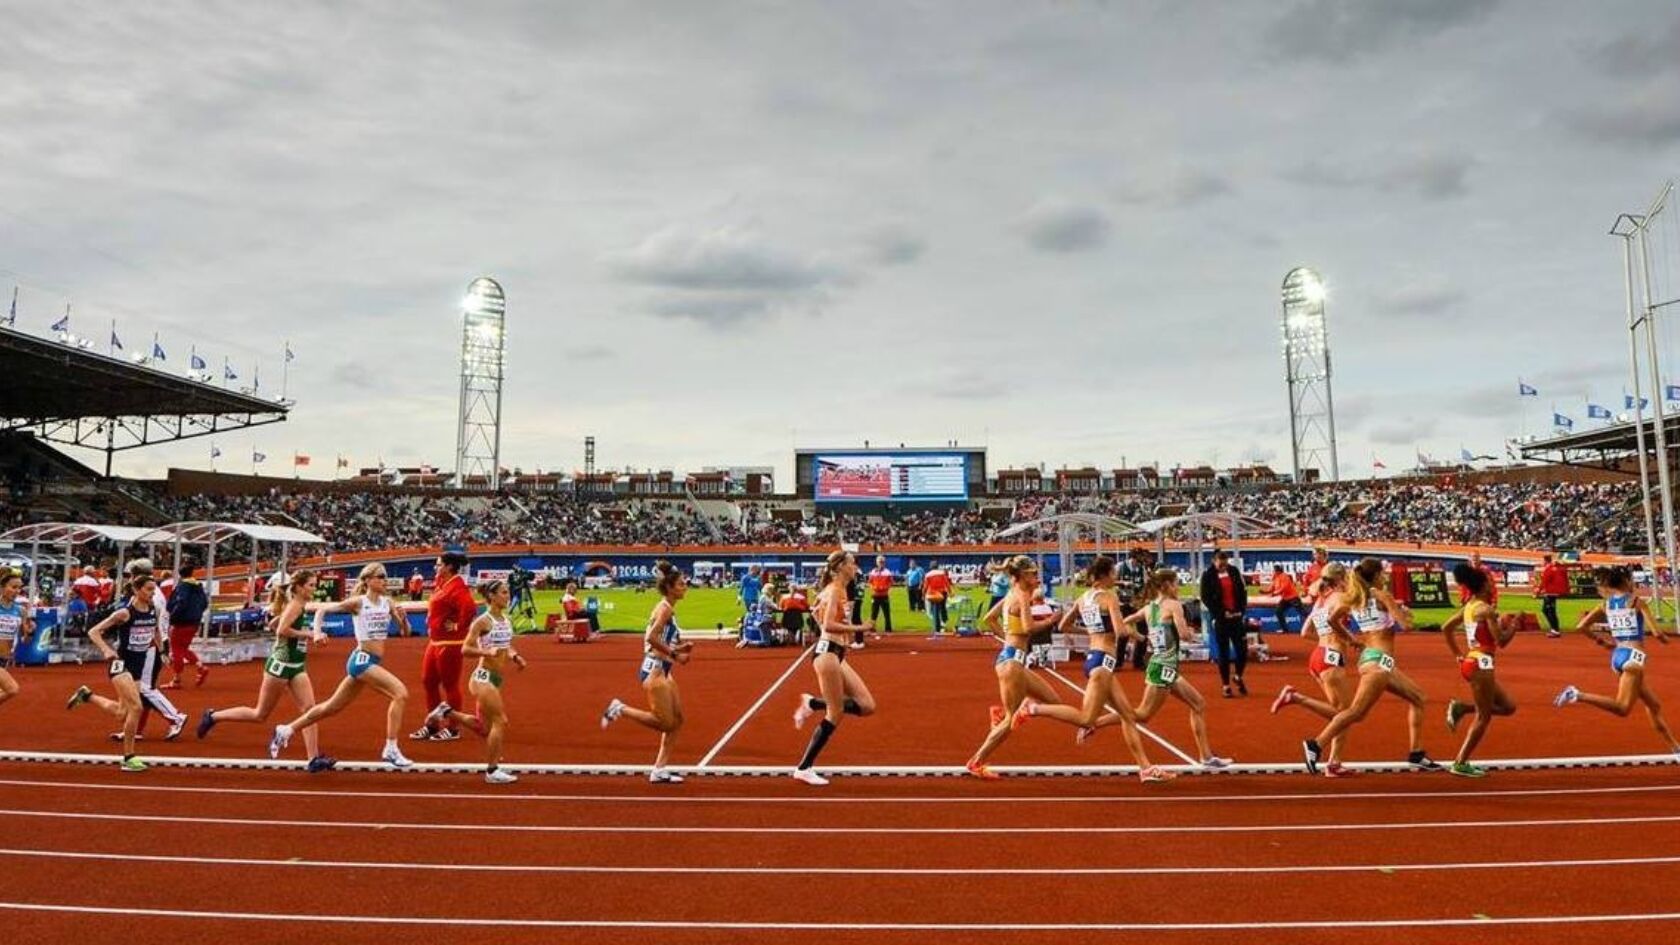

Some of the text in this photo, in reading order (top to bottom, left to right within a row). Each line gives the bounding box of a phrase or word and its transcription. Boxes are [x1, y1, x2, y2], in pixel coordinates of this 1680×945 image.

[1612, 616, 1633, 628] 215
[1382, 655, 1393, 668] 10
[477, 670, 488, 680] 16
[1163, 668, 1174, 680] 17
